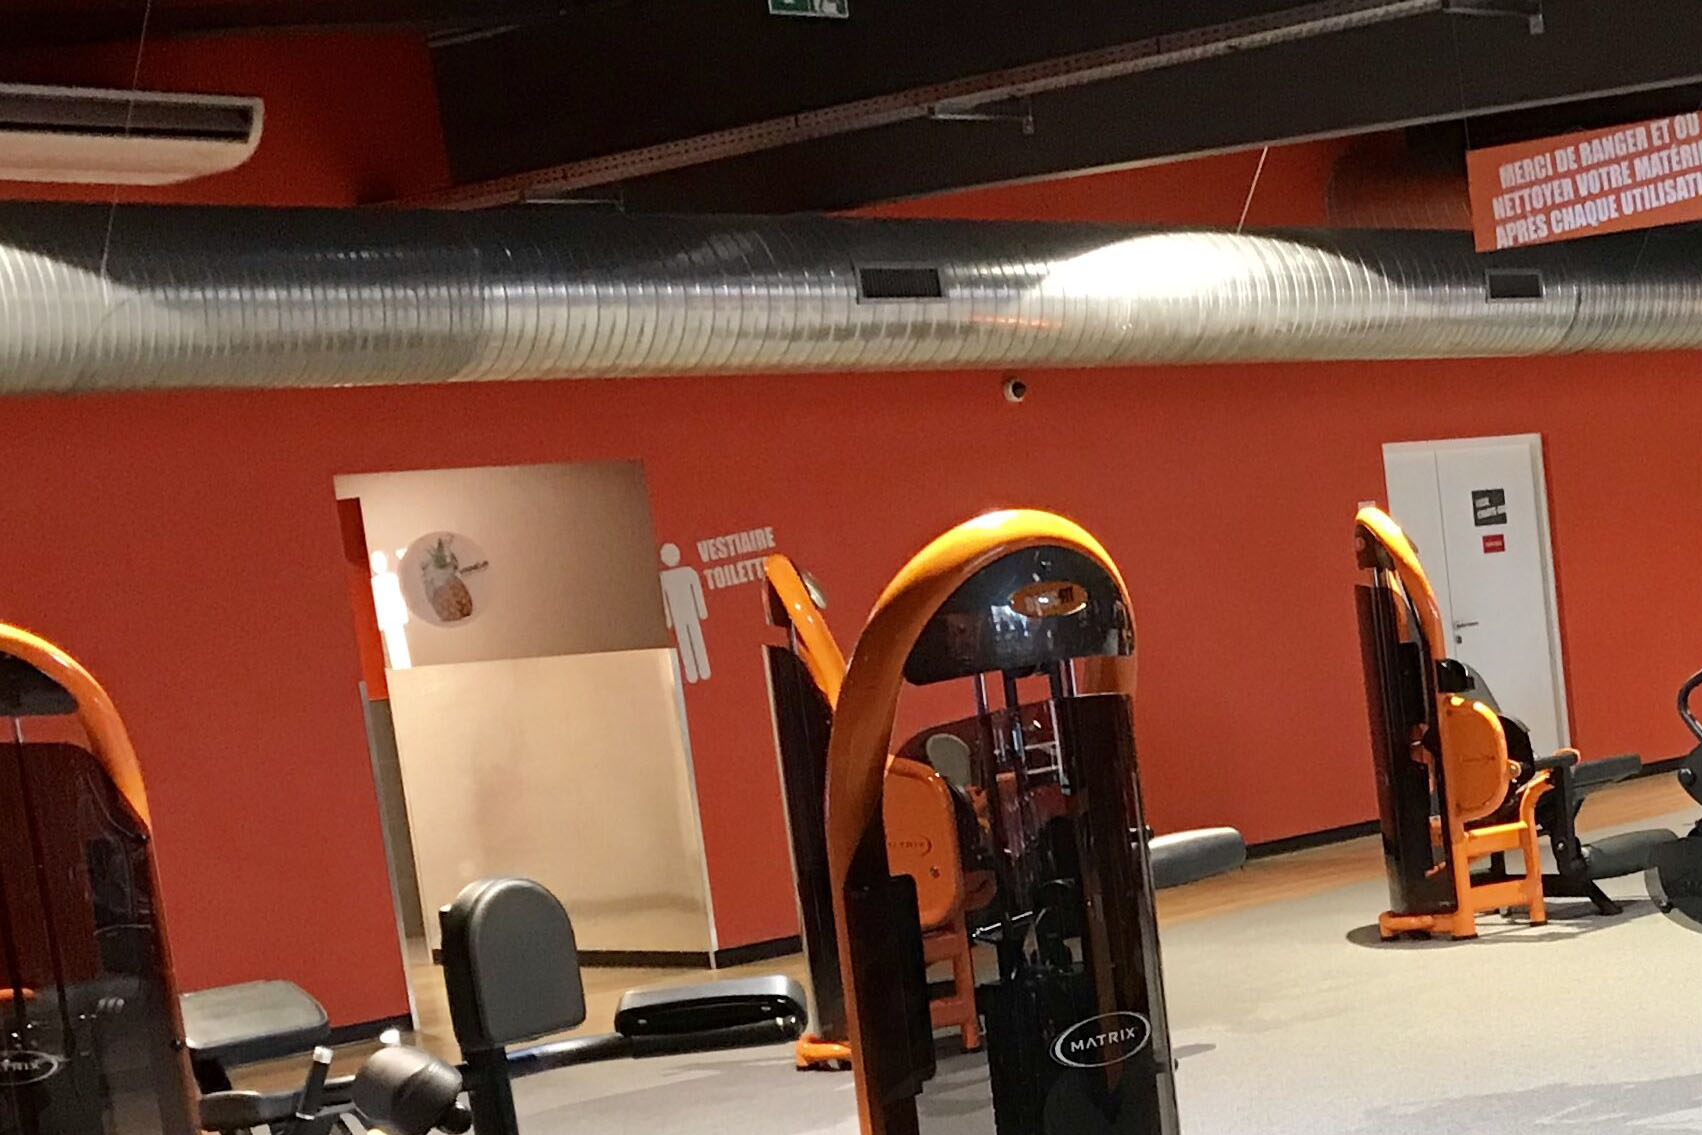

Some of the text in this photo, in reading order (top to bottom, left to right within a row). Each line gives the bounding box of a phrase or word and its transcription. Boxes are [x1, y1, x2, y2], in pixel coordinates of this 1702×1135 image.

[1499, 112, 1700, 189] MERCI DE RANGER ET OU
[1492, 177, 1575, 219] NETTOYER
[1576, 161, 1632, 197] VOTRE
[1495, 212, 1549, 250] APRÈS
[1550, 195, 1619, 233] CHAQUE
[696, 526, 776, 563] VESTIAIRE
[1070, 1027, 1135, 1053] MATRIX
